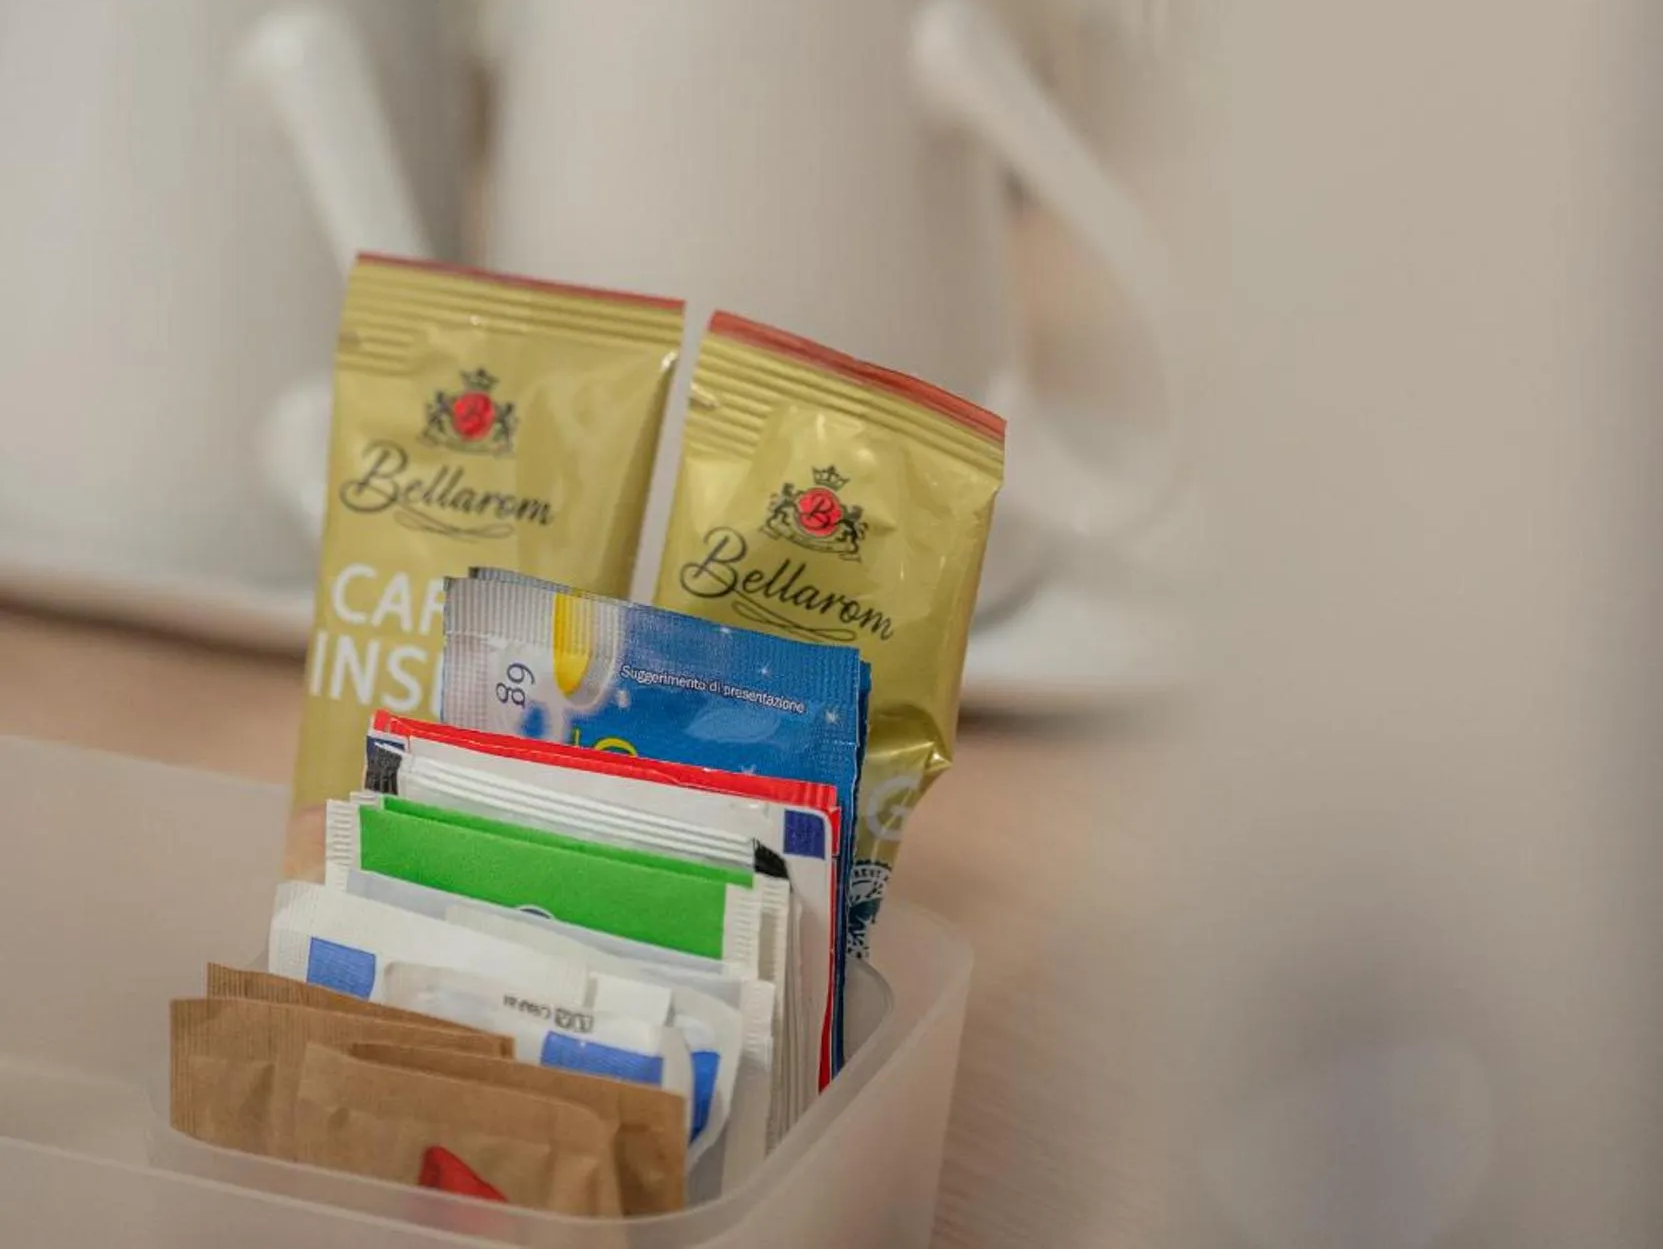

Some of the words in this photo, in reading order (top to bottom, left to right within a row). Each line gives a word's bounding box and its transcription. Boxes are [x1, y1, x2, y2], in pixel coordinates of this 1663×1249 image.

[339, 439, 554, 528] Bellarom
[680, 526, 894, 641] Bellarom
[620, 663, 706, 691] Suggerimento
[709, 680, 722, 694] di
